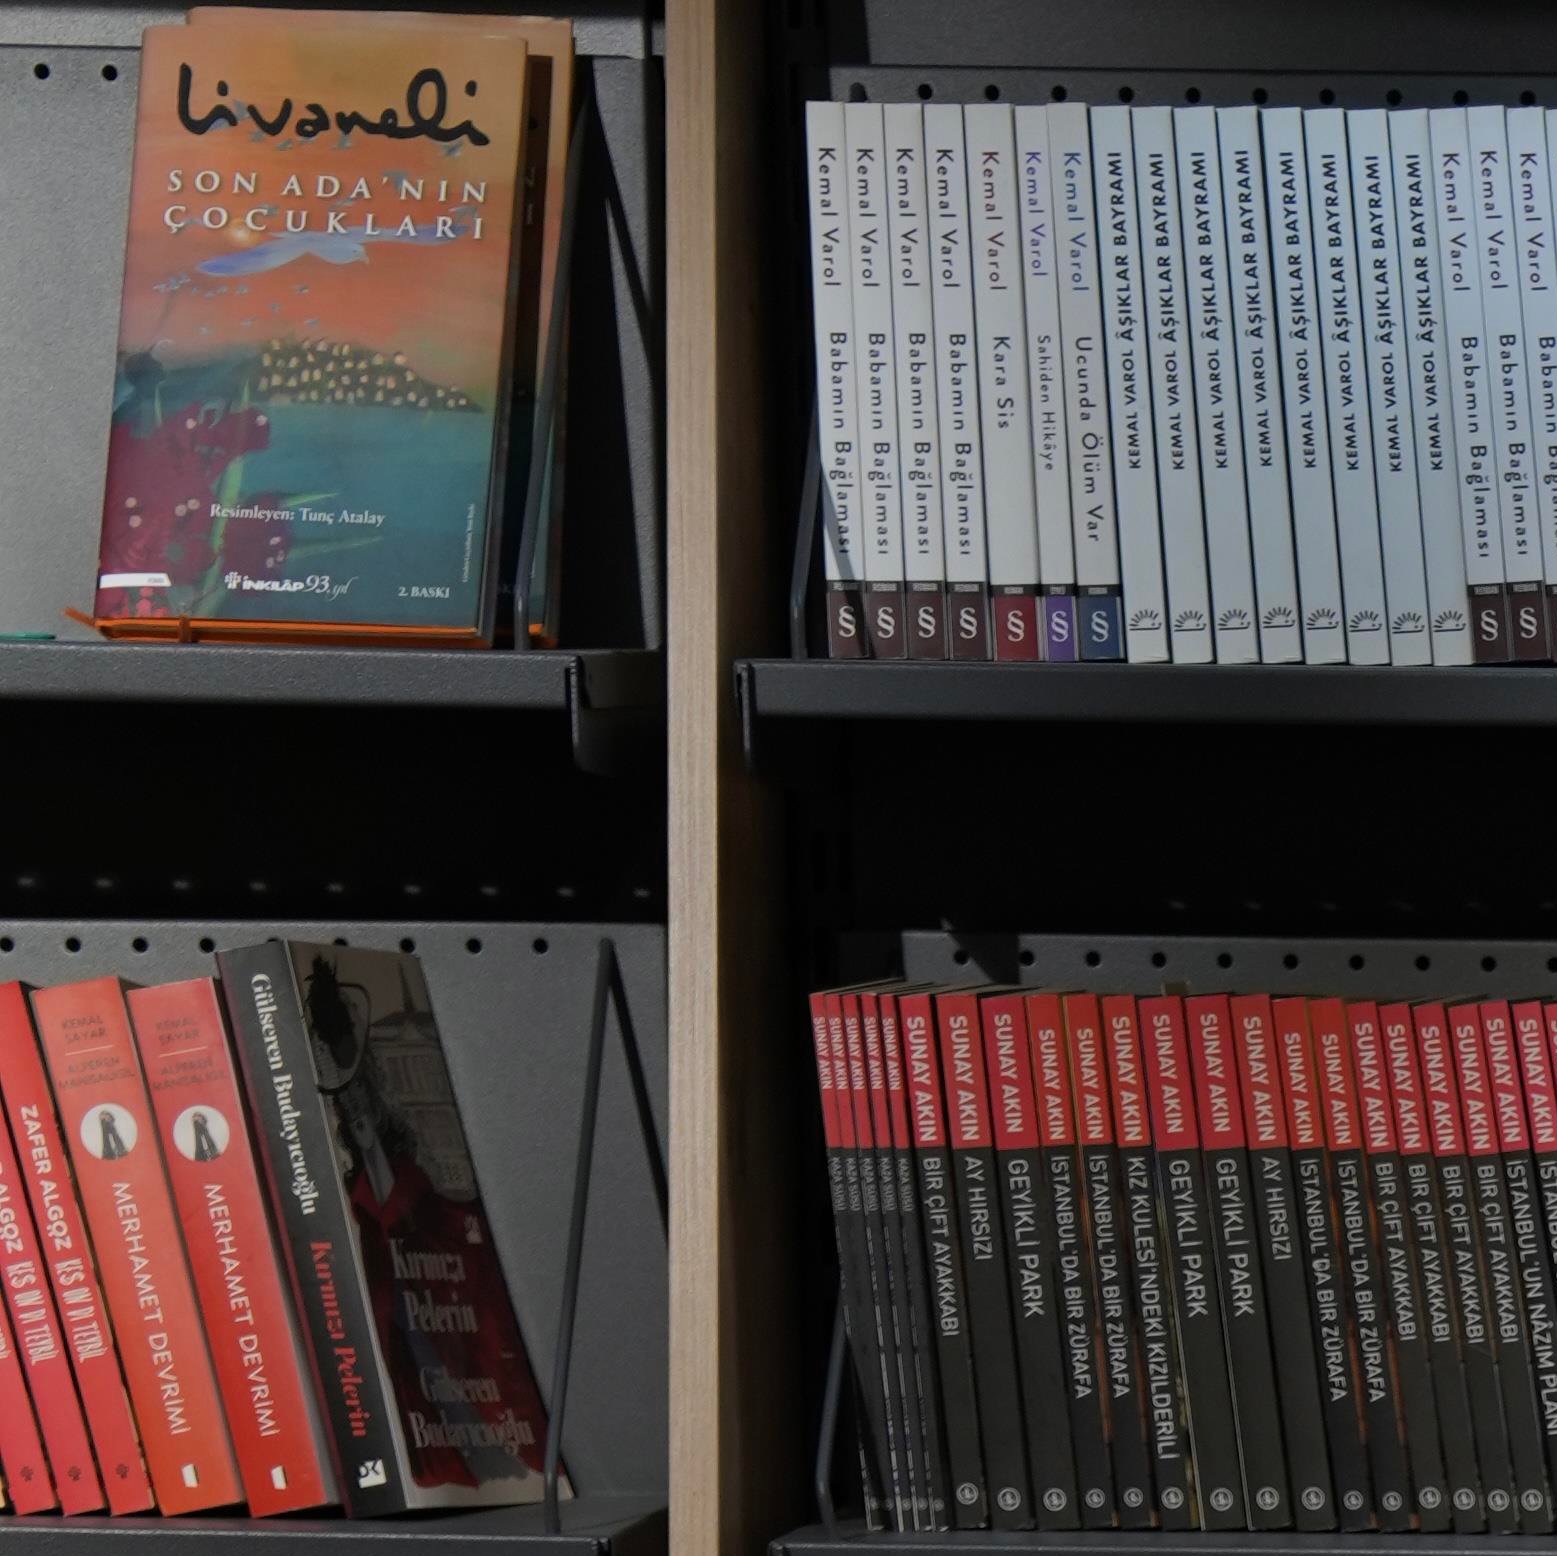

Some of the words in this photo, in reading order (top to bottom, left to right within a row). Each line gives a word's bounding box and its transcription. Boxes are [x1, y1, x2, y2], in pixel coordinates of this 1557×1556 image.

[166, 169, 258, 195] SON
[818, 147, 839, 218] Kemal
[1107, 151, 1128, 245] BAYRAMI
[164, 205, 485, 241] ÇOCUKLARI
[821, 227, 842, 287] Varol
[1112, 250, 1136, 341] ÂŞIKLAR
[829, 332, 846, 431] Babamın
[993, 335, 1009, 387] Kara
[1075, 336, 1093, 421] Ucunda
[1121, 342, 1137, 406] VAROL
[997, 398, 1014, 430] Sis
[1126, 410, 1142, 470] KEMAL
[1082, 432, 1100, 495] Ölüm
[210, 502, 294, 523] Resimleyen:
[300, 506, 334, 525] Tunç
[340, 510, 386, 528] Atalay
[828, 440, 853, 554] Bağlaması
[1087, 505, 1104, 542] Var
[252, 972, 282, 1070] Gülseren
[270, 1074, 321, 1216] Budayıcıoğlu
[112, 1182, 165, 1327] MERHAMET
[147, 1332, 191, 1436] DEVRİMİ
[930, 1243, 959, 1337] AYAKKABI
